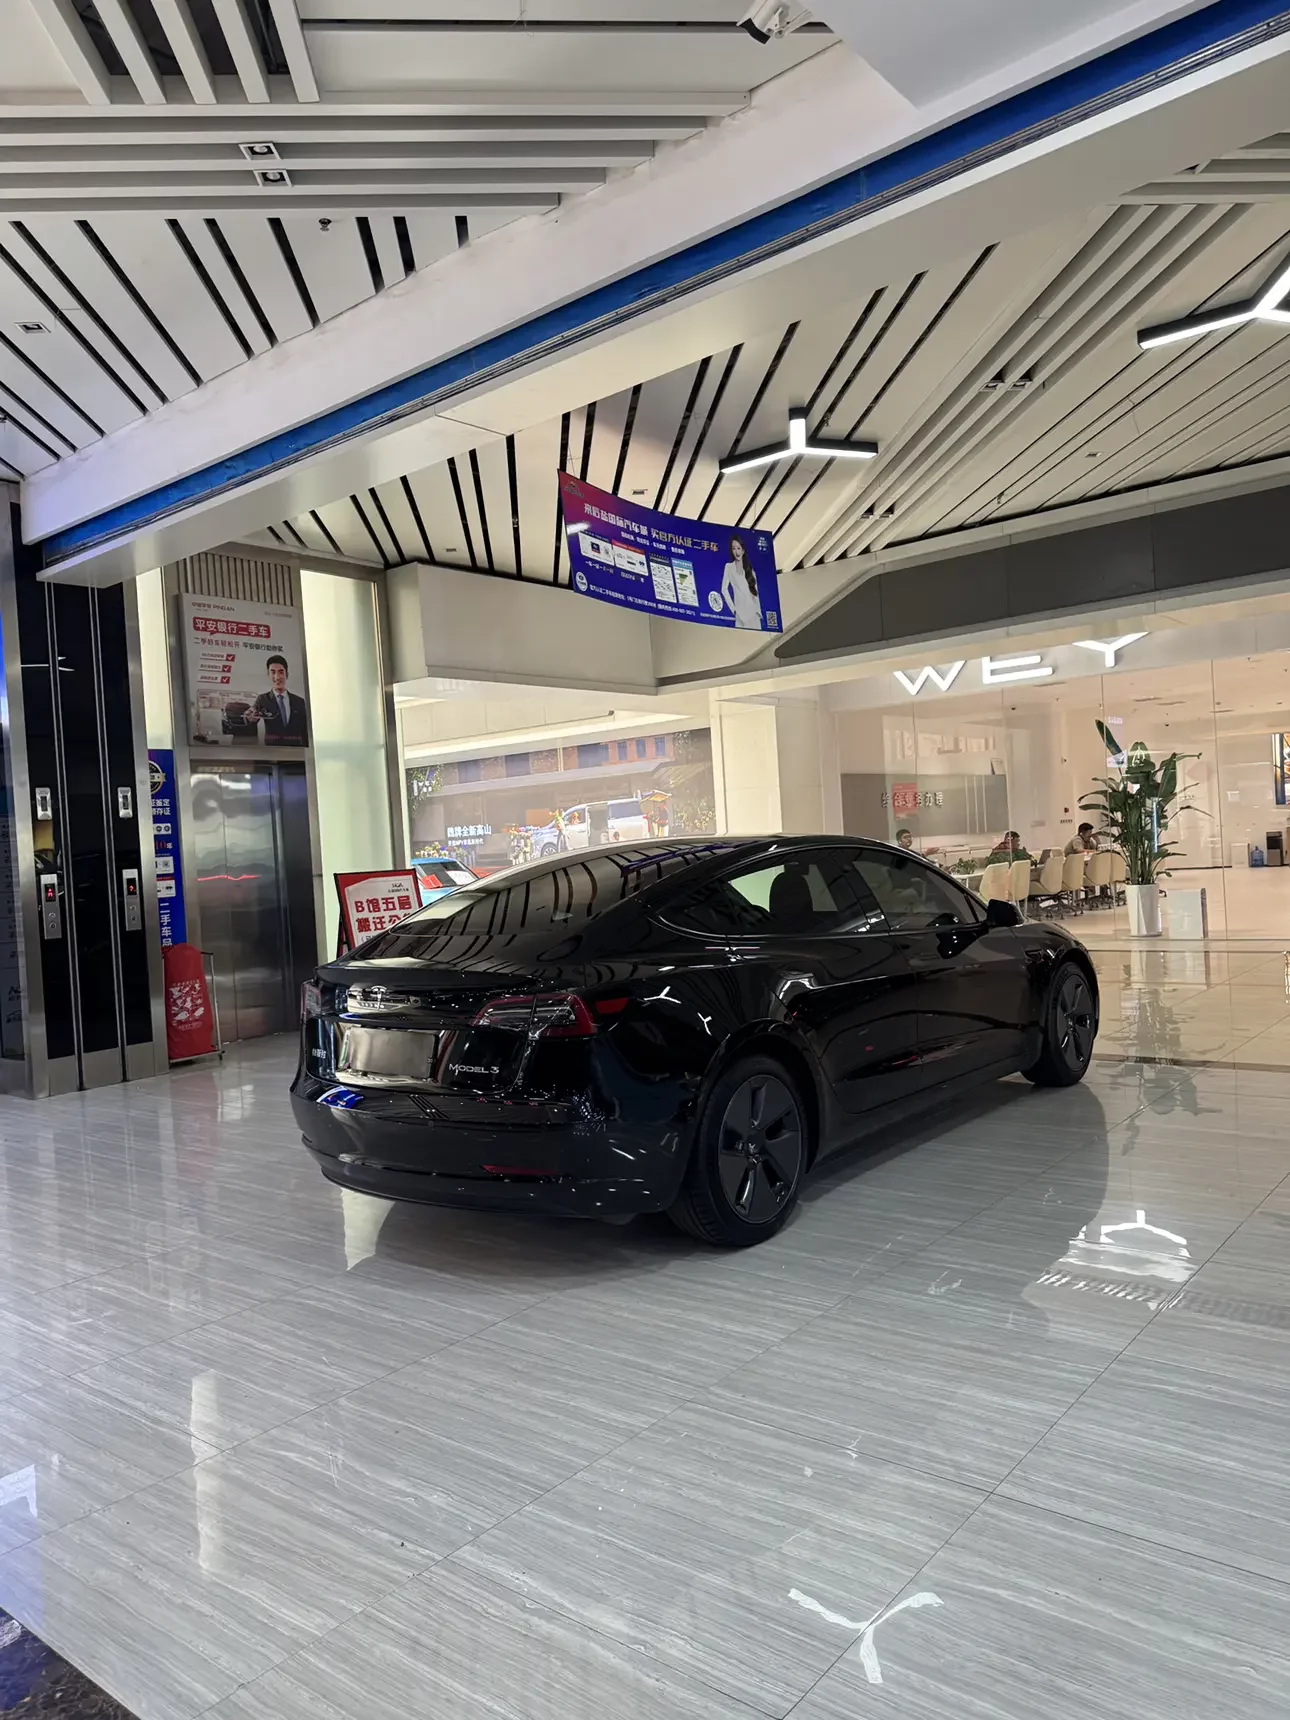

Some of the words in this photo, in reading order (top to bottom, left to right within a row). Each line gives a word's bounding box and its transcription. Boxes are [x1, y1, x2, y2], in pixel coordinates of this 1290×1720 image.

[195, 619, 268, 636] 平安银行二手车
[893, 631, 1149, 696] WEY
[355, 895, 412, 913] B馆五层
[449, 1063, 489, 1074] MODEL
[490, 1066, 499, 1074] 3
